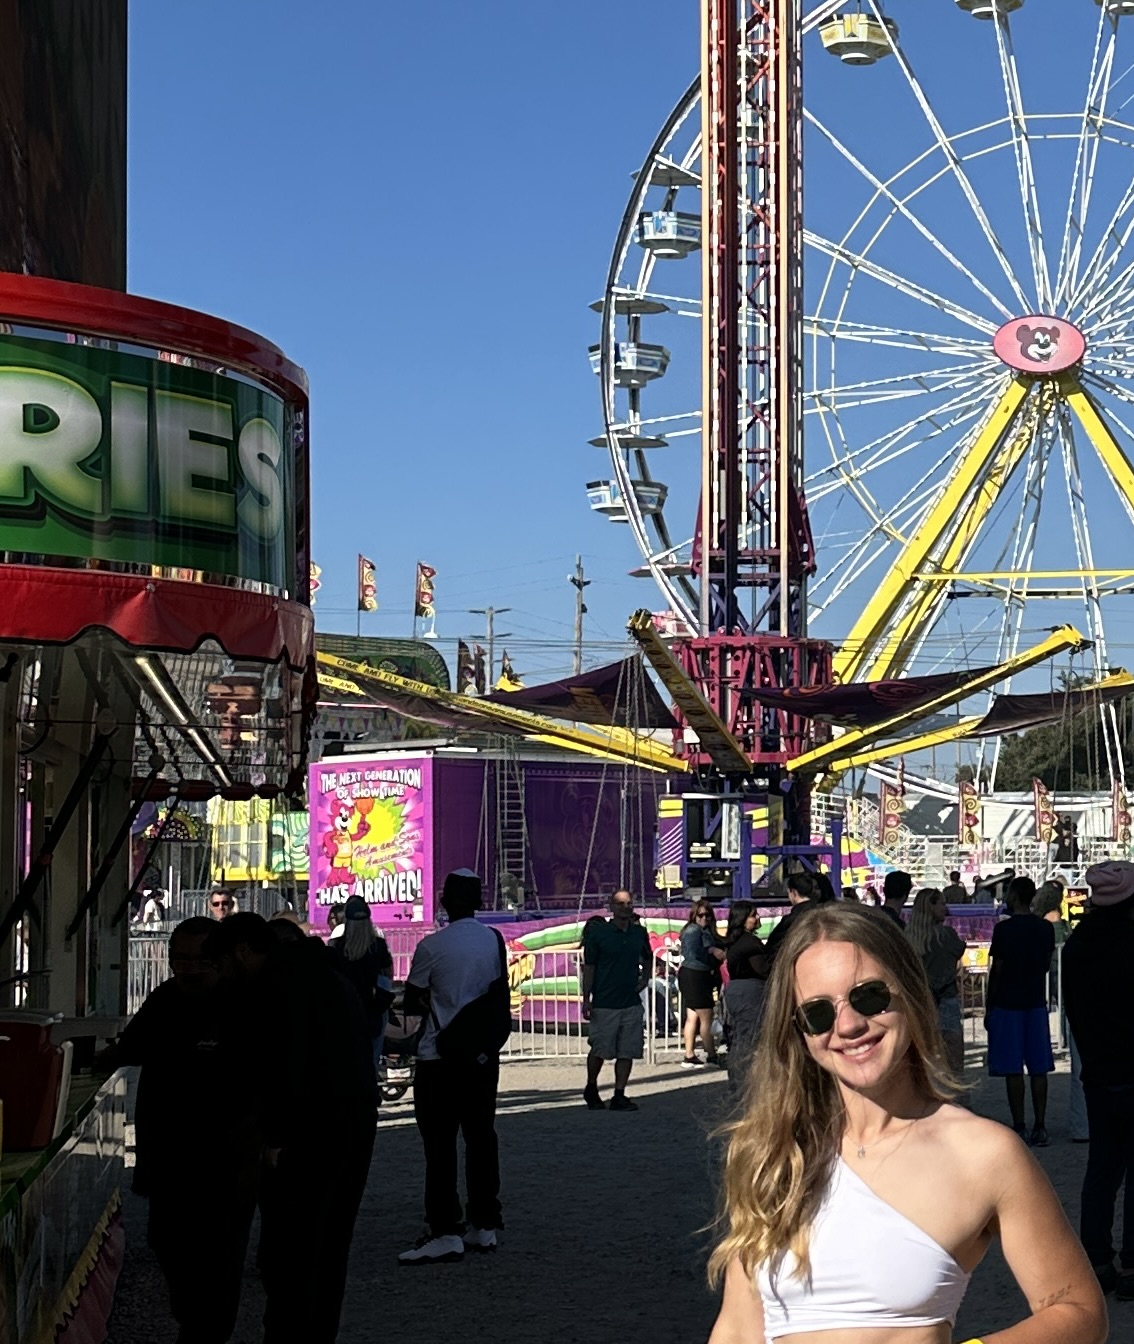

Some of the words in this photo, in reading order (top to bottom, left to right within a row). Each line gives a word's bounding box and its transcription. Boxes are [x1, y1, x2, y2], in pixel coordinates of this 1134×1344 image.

[0, 366, 282, 539] RIES
[384, 673, 399, 684] FLY
[403, 679, 423, 691] WITH
[320, 773, 337, 795] THE
[339, 771, 362, 787] NEXT
[364, 768, 421, 790] GENERATION
[336, 787, 349, 800] OF
[380, 837, 399, 851] and
[320, 884, 349, 904] HAS
[354, 868, 422, 903] ARRIVED!
